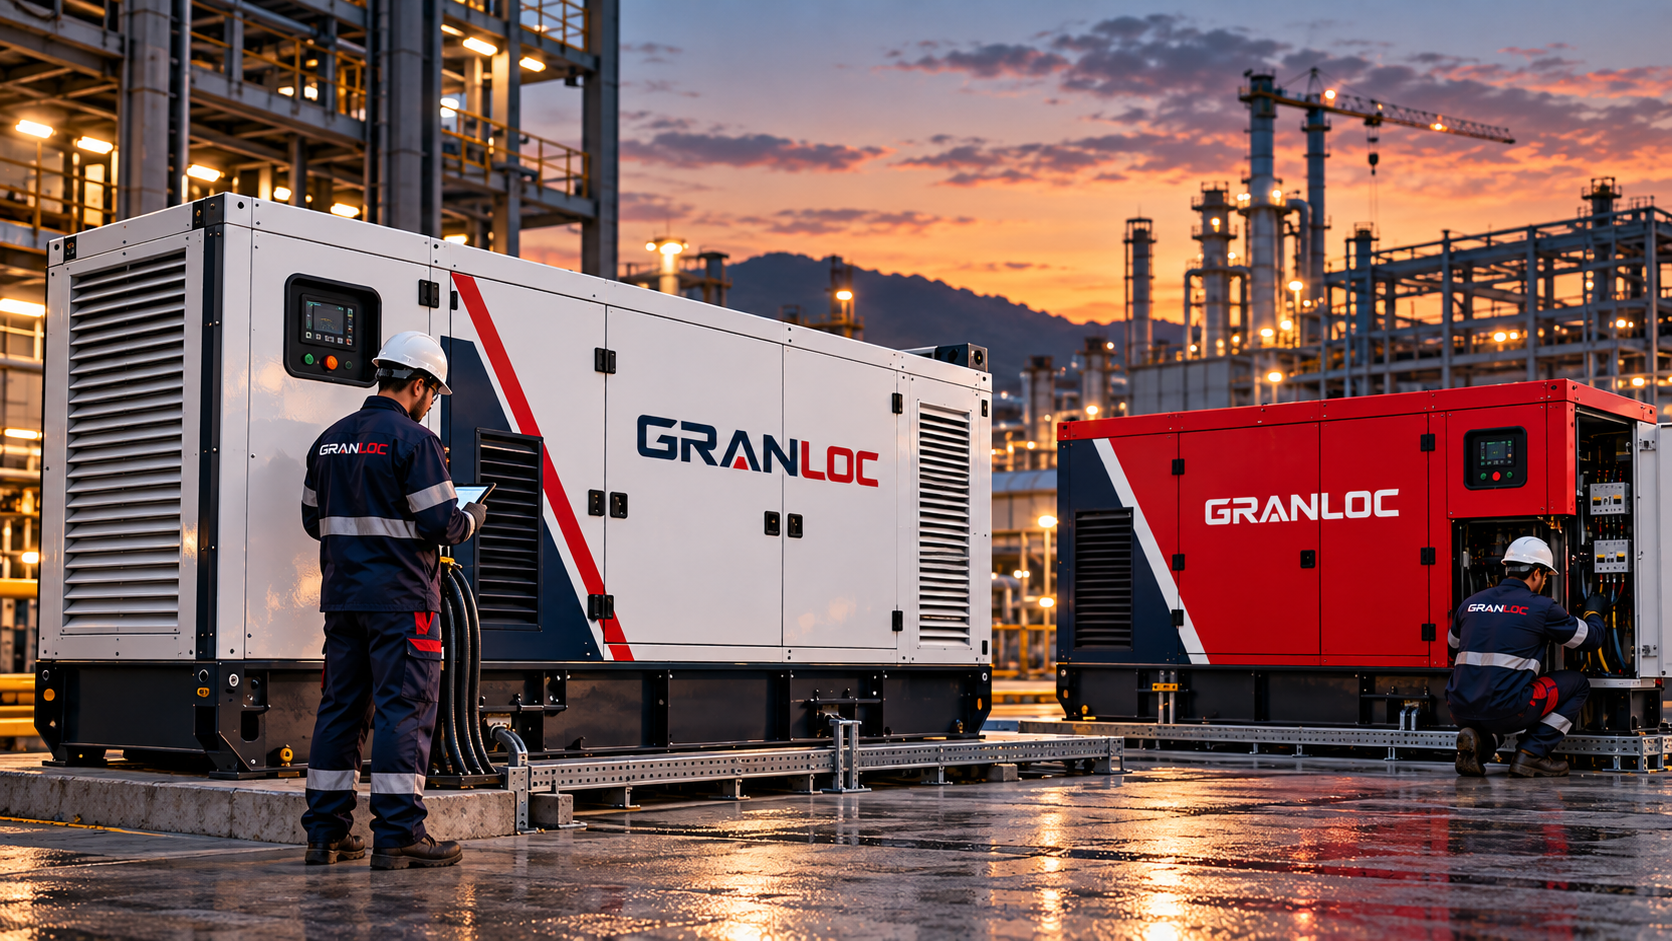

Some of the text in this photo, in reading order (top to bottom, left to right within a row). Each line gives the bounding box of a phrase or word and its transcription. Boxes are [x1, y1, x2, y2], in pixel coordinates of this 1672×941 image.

[319, 442, 389, 456] GRANLOC
[637, 414, 879, 488] GRANLOC
[1204, 488, 1400, 526] GRANLOC
[1467, 603, 1529, 616] GRANLOC
